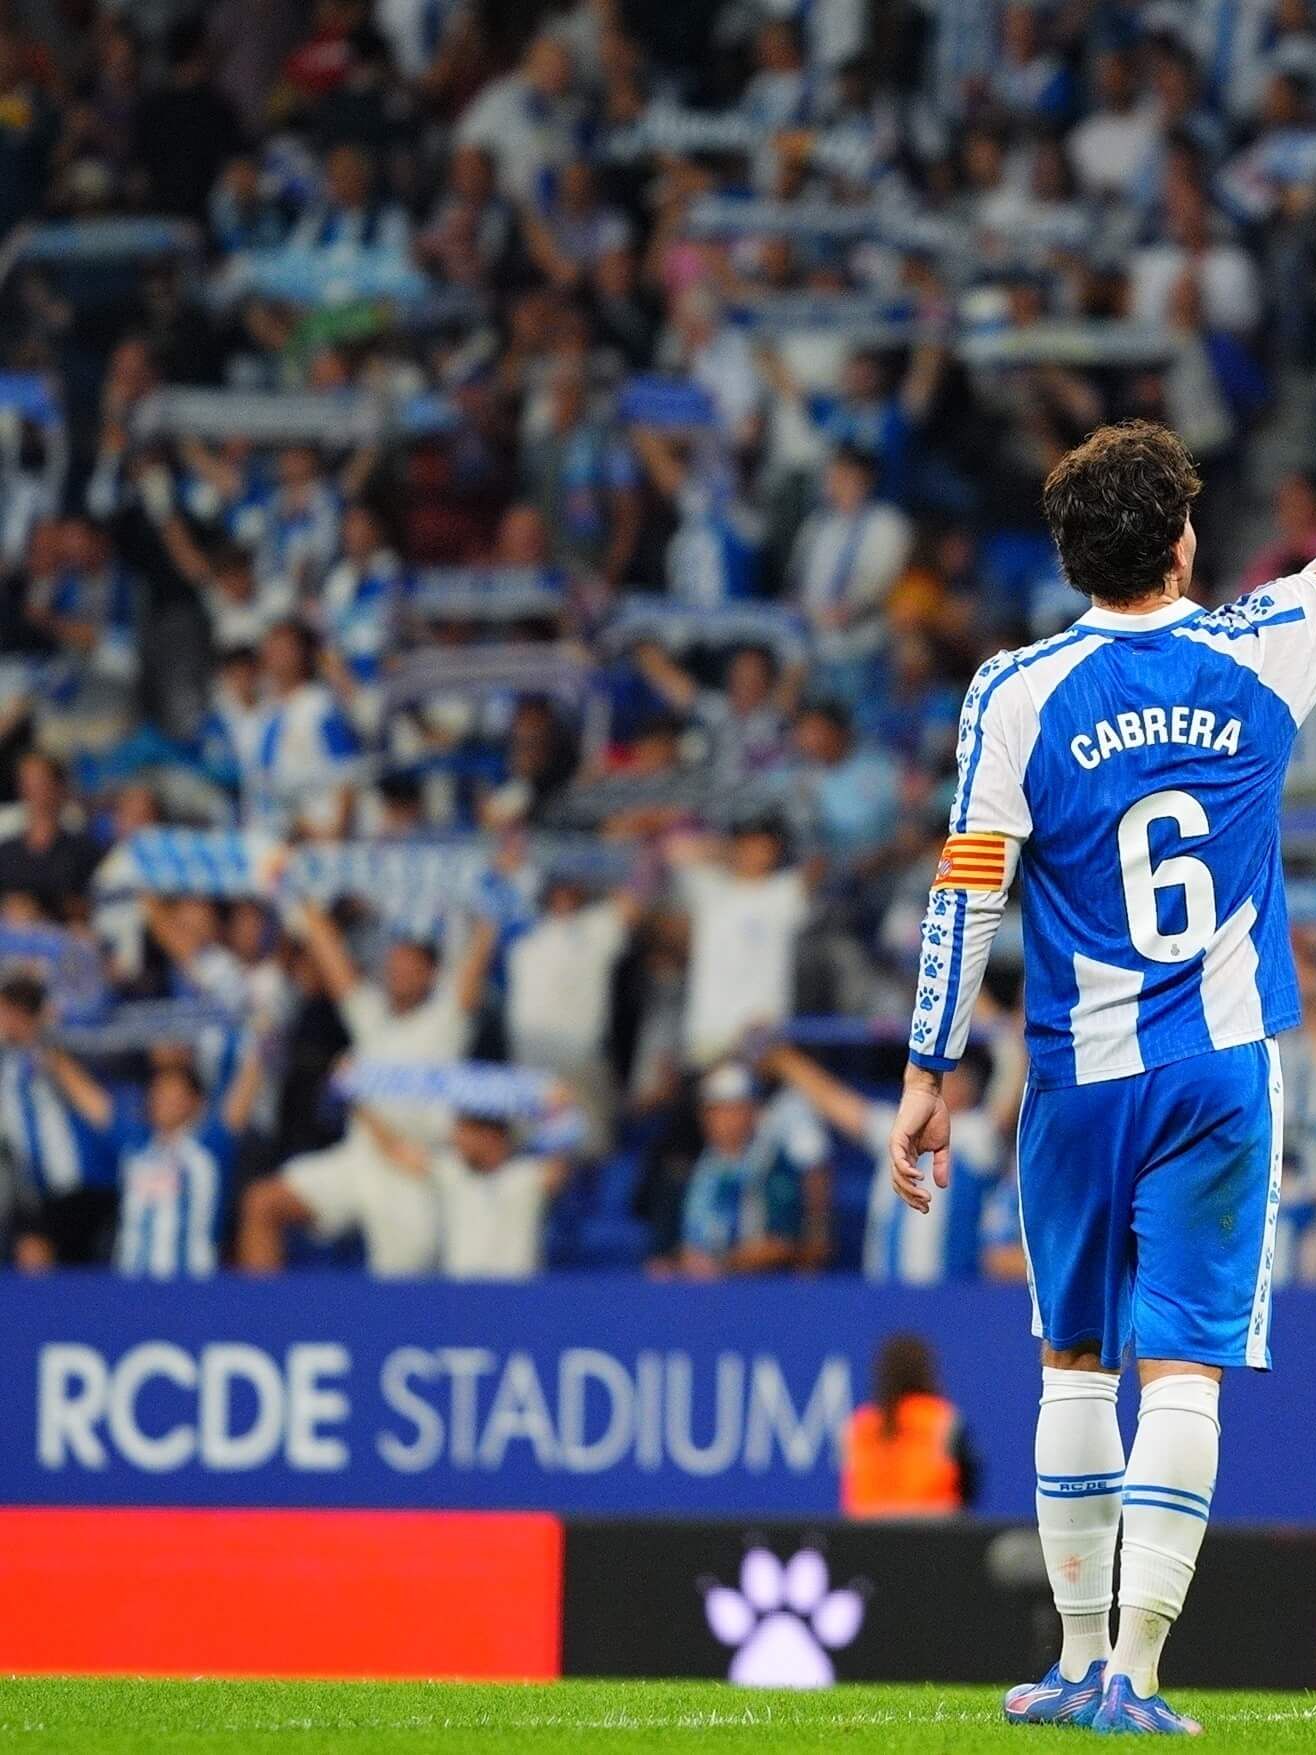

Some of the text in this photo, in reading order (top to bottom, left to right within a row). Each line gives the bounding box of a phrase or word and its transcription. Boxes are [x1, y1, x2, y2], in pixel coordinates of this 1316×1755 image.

[1070, 706, 1242, 770] CABRERA
[1117, 789, 1217, 963] 6
[37, 1342, 852, 1474] RCDE STADIUM
[1060, 1481, 1107, 1491] RCDE
